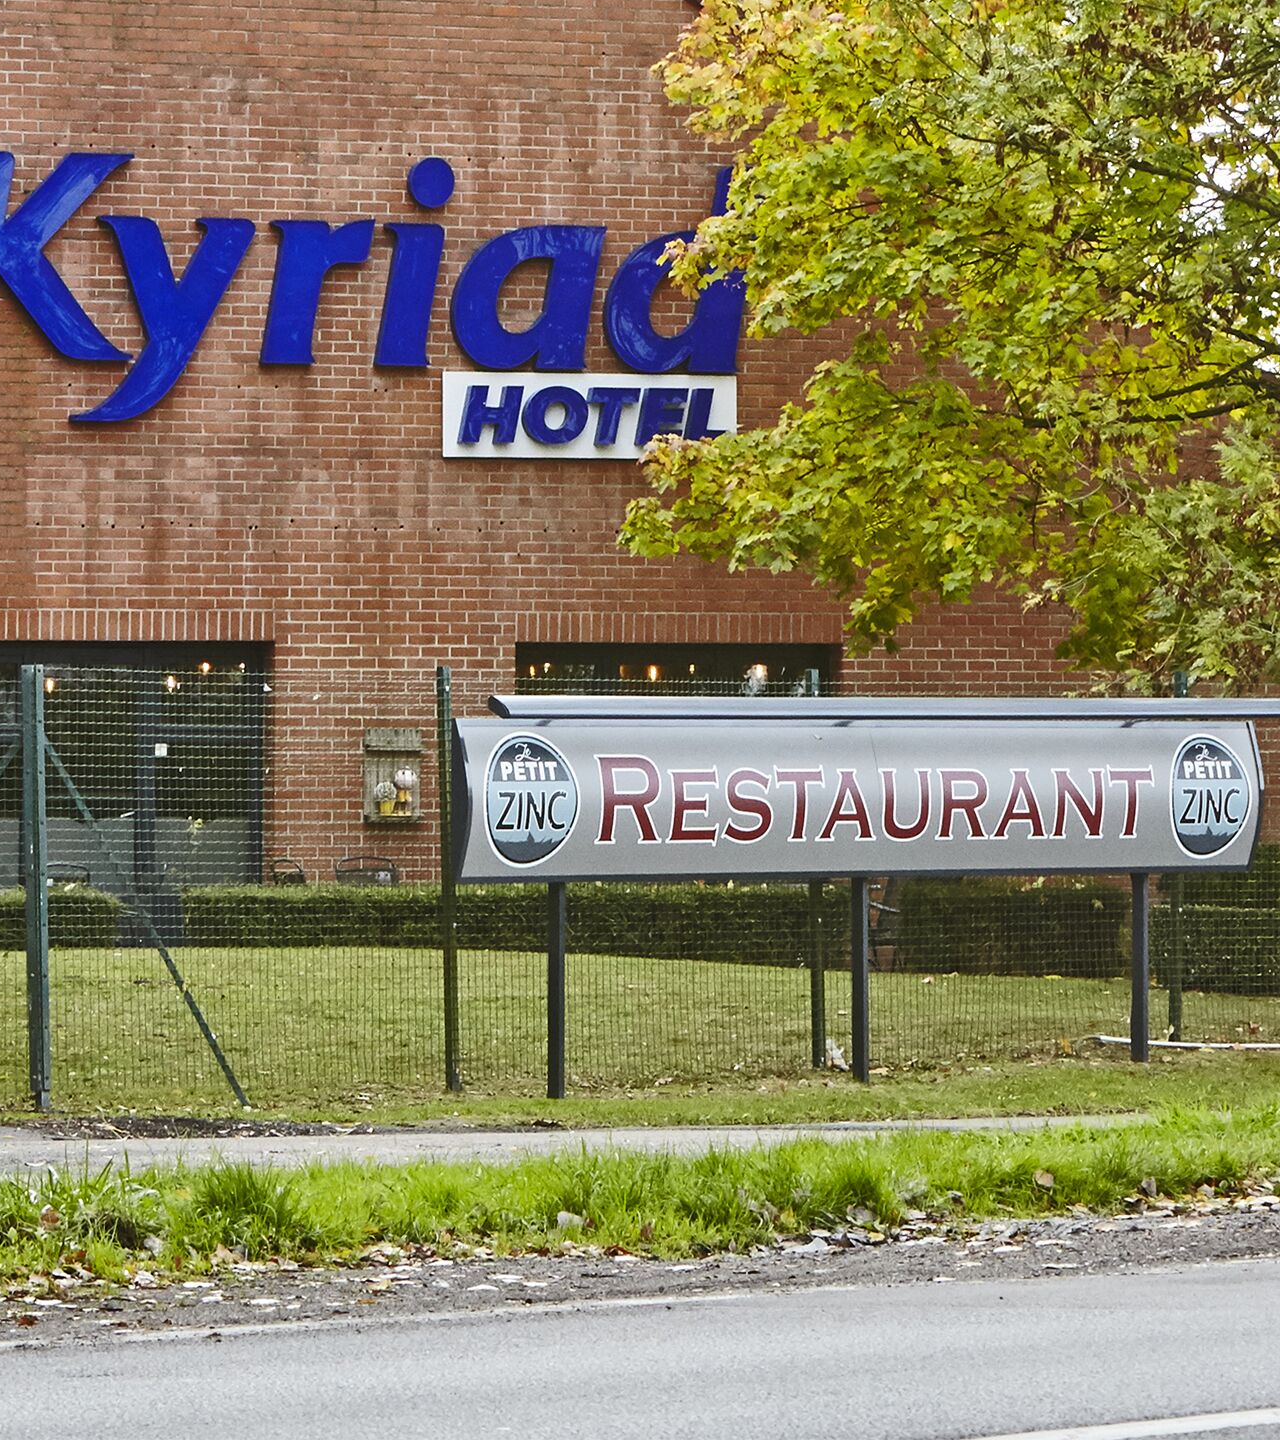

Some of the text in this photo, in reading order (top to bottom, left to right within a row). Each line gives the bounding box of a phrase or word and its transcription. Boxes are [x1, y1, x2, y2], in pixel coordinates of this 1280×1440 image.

[457, 384, 738, 448] HOTEL
[500, 761, 558, 781] PETIT
[1183, 760, 1232, 779] PETIT
[495, 790, 567, 831] ZINC
[593, 753, 1155, 847] RESTAURANT
[1179, 788, 1240, 825] ZINC
